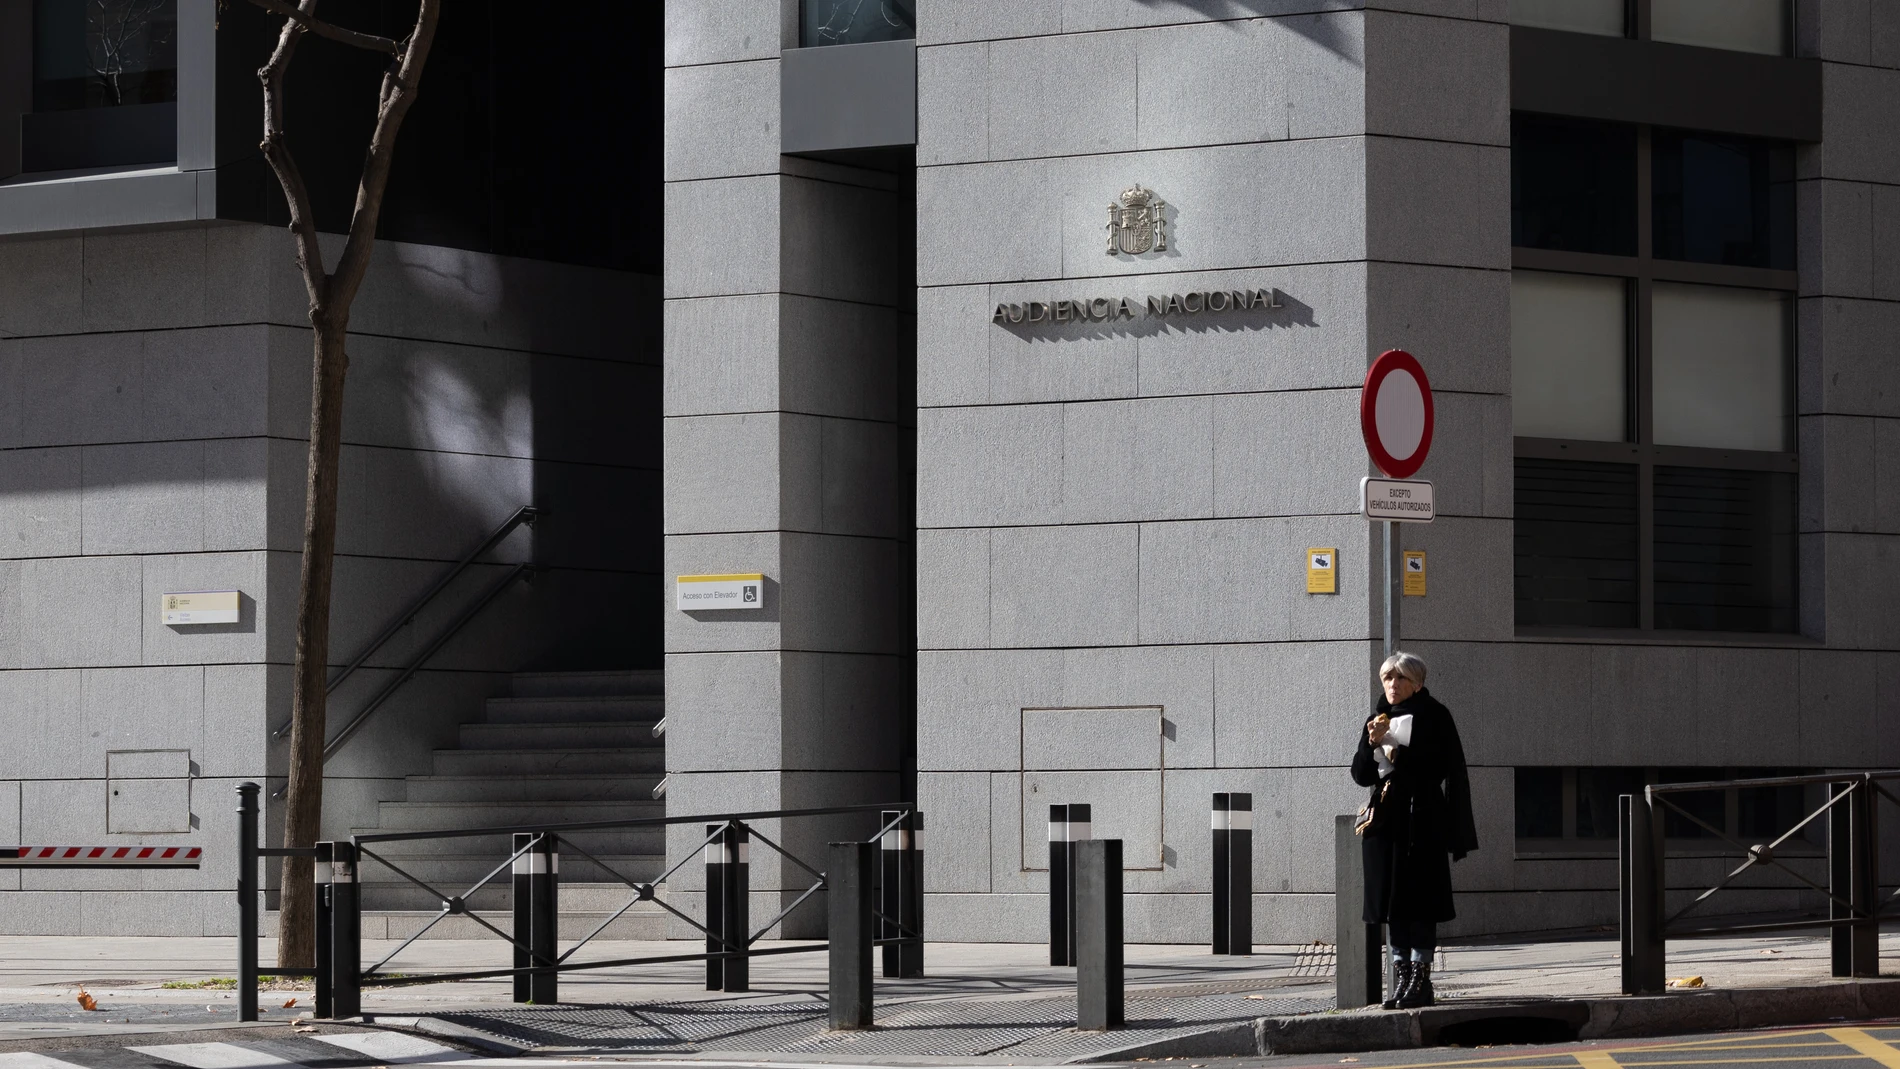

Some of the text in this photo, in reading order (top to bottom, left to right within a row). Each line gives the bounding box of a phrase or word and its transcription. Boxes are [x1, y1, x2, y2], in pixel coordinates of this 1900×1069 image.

[993, 288, 1282, 323] AUDIENCIA NACIONAL
[1389, 488, 1411, 498] EXCEPTO
[1397, 501, 1431, 512] AUTORIZADOS
[714, 591, 738, 599] Elevador
